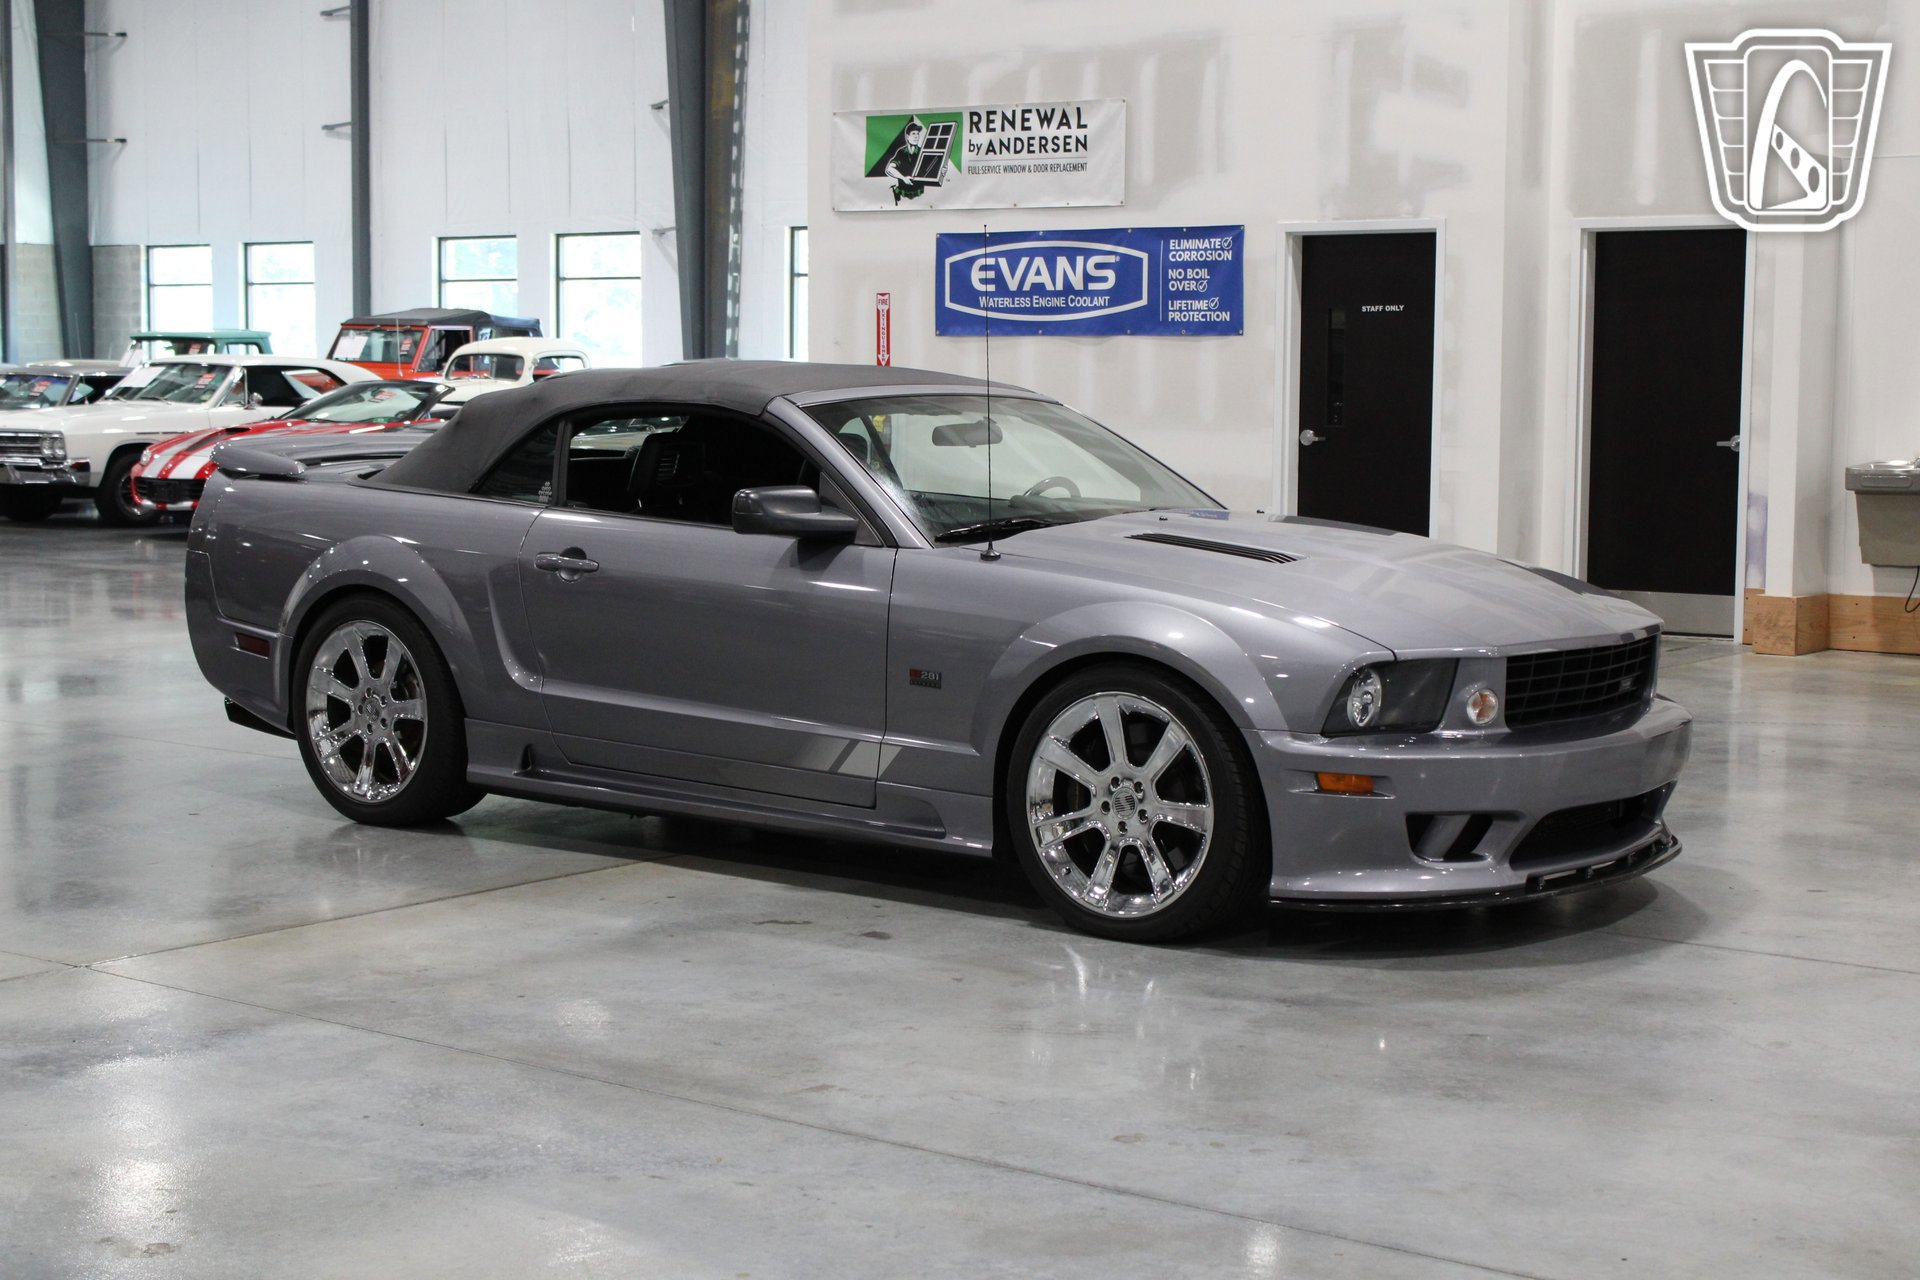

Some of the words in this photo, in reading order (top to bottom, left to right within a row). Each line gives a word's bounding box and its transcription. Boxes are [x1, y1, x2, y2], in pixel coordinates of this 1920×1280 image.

[968, 106, 1088, 133] RENEWAL
[968, 138, 982, 155] by
[985, 134, 1088, 155] ANDERSEN
[1003, 163, 1027, 174] WINDOW
[1027, 163, 1032, 173] &
[1033, 163, 1048, 173] DOOR
[1049, 162, 1088, 173] REPLACEMENT
[1169, 238, 1222, 250] ELIMINATE
[1168, 250, 1233, 262] CORROSION
[970, 255, 1116, 291] EVANS
[1168, 268, 1185, 280] NO
[1186, 268, 1211, 279] BOIL
[1168, 280, 1198, 291] OVER
[1032, 295, 1067, 308] ENGINE
[1067, 294, 1111, 308] COOLANT
[1168, 300, 1209, 311] LIFETIME
[1168, 311, 1231, 322] PROTECTION
